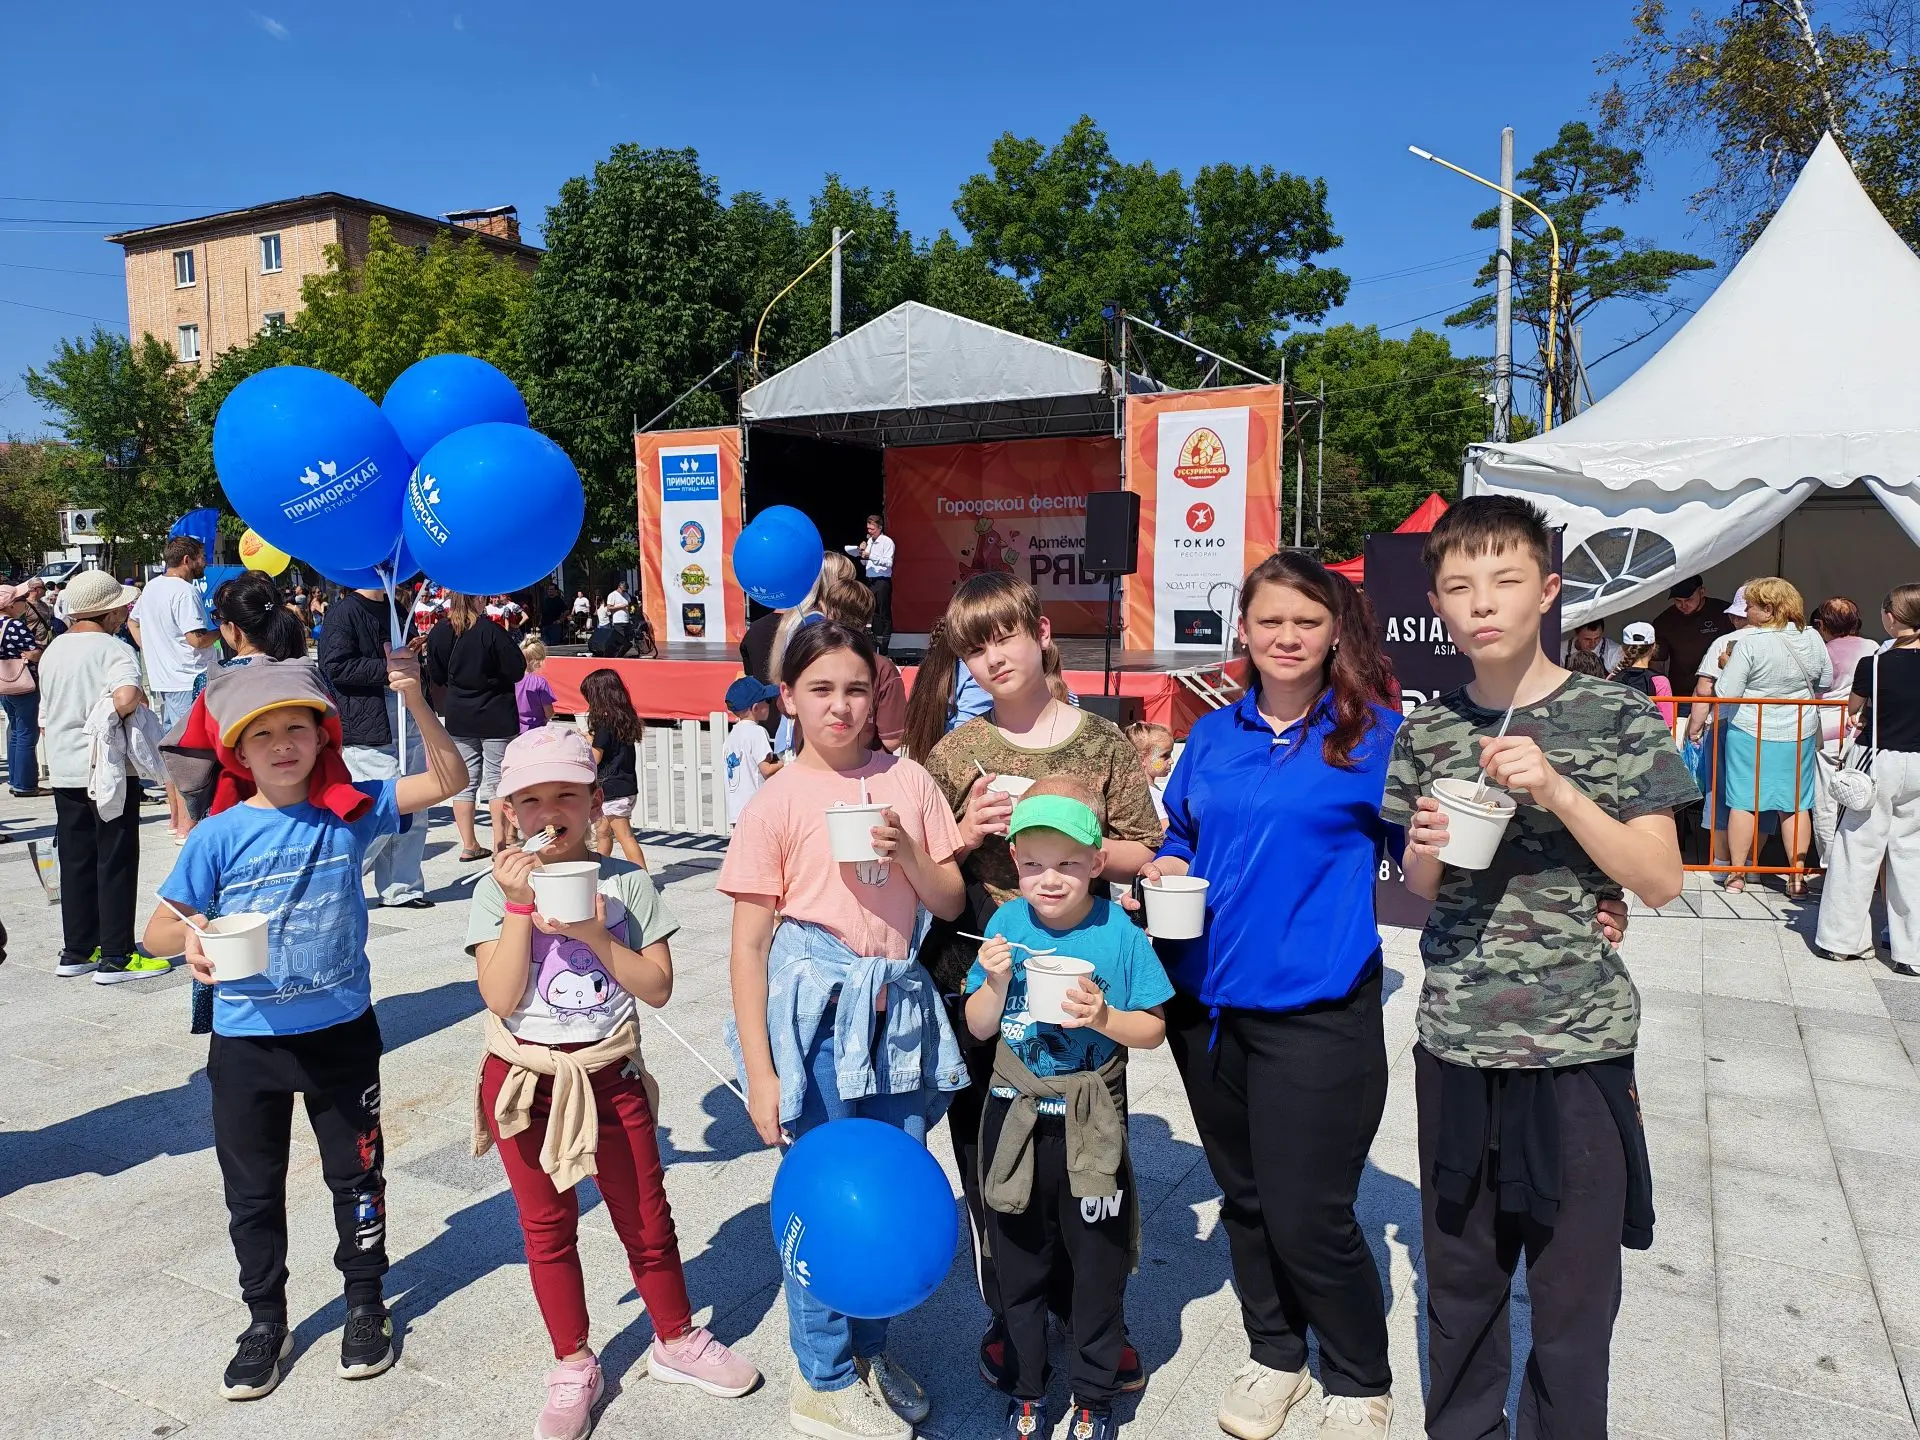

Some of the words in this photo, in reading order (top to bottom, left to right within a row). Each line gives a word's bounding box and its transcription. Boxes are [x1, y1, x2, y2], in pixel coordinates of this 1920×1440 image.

[283, 461, 379, 520] ПРИМОРСКАЯ
[666, 475, 715, 487] ПРИМОРСКАЯ
[323, 493, 358, 514] ПТИЦА
[937, 494, 1025, 516] Городской
[1173, 538, 1226, 549] ТОКИО
[1166, 581, 1197, 590] ХОДЯТ
[1433, 644, 1457, 656] ASIA
[275, 981, 308, 1005] Be
[1080, 1190, 1123, 1223] ON
